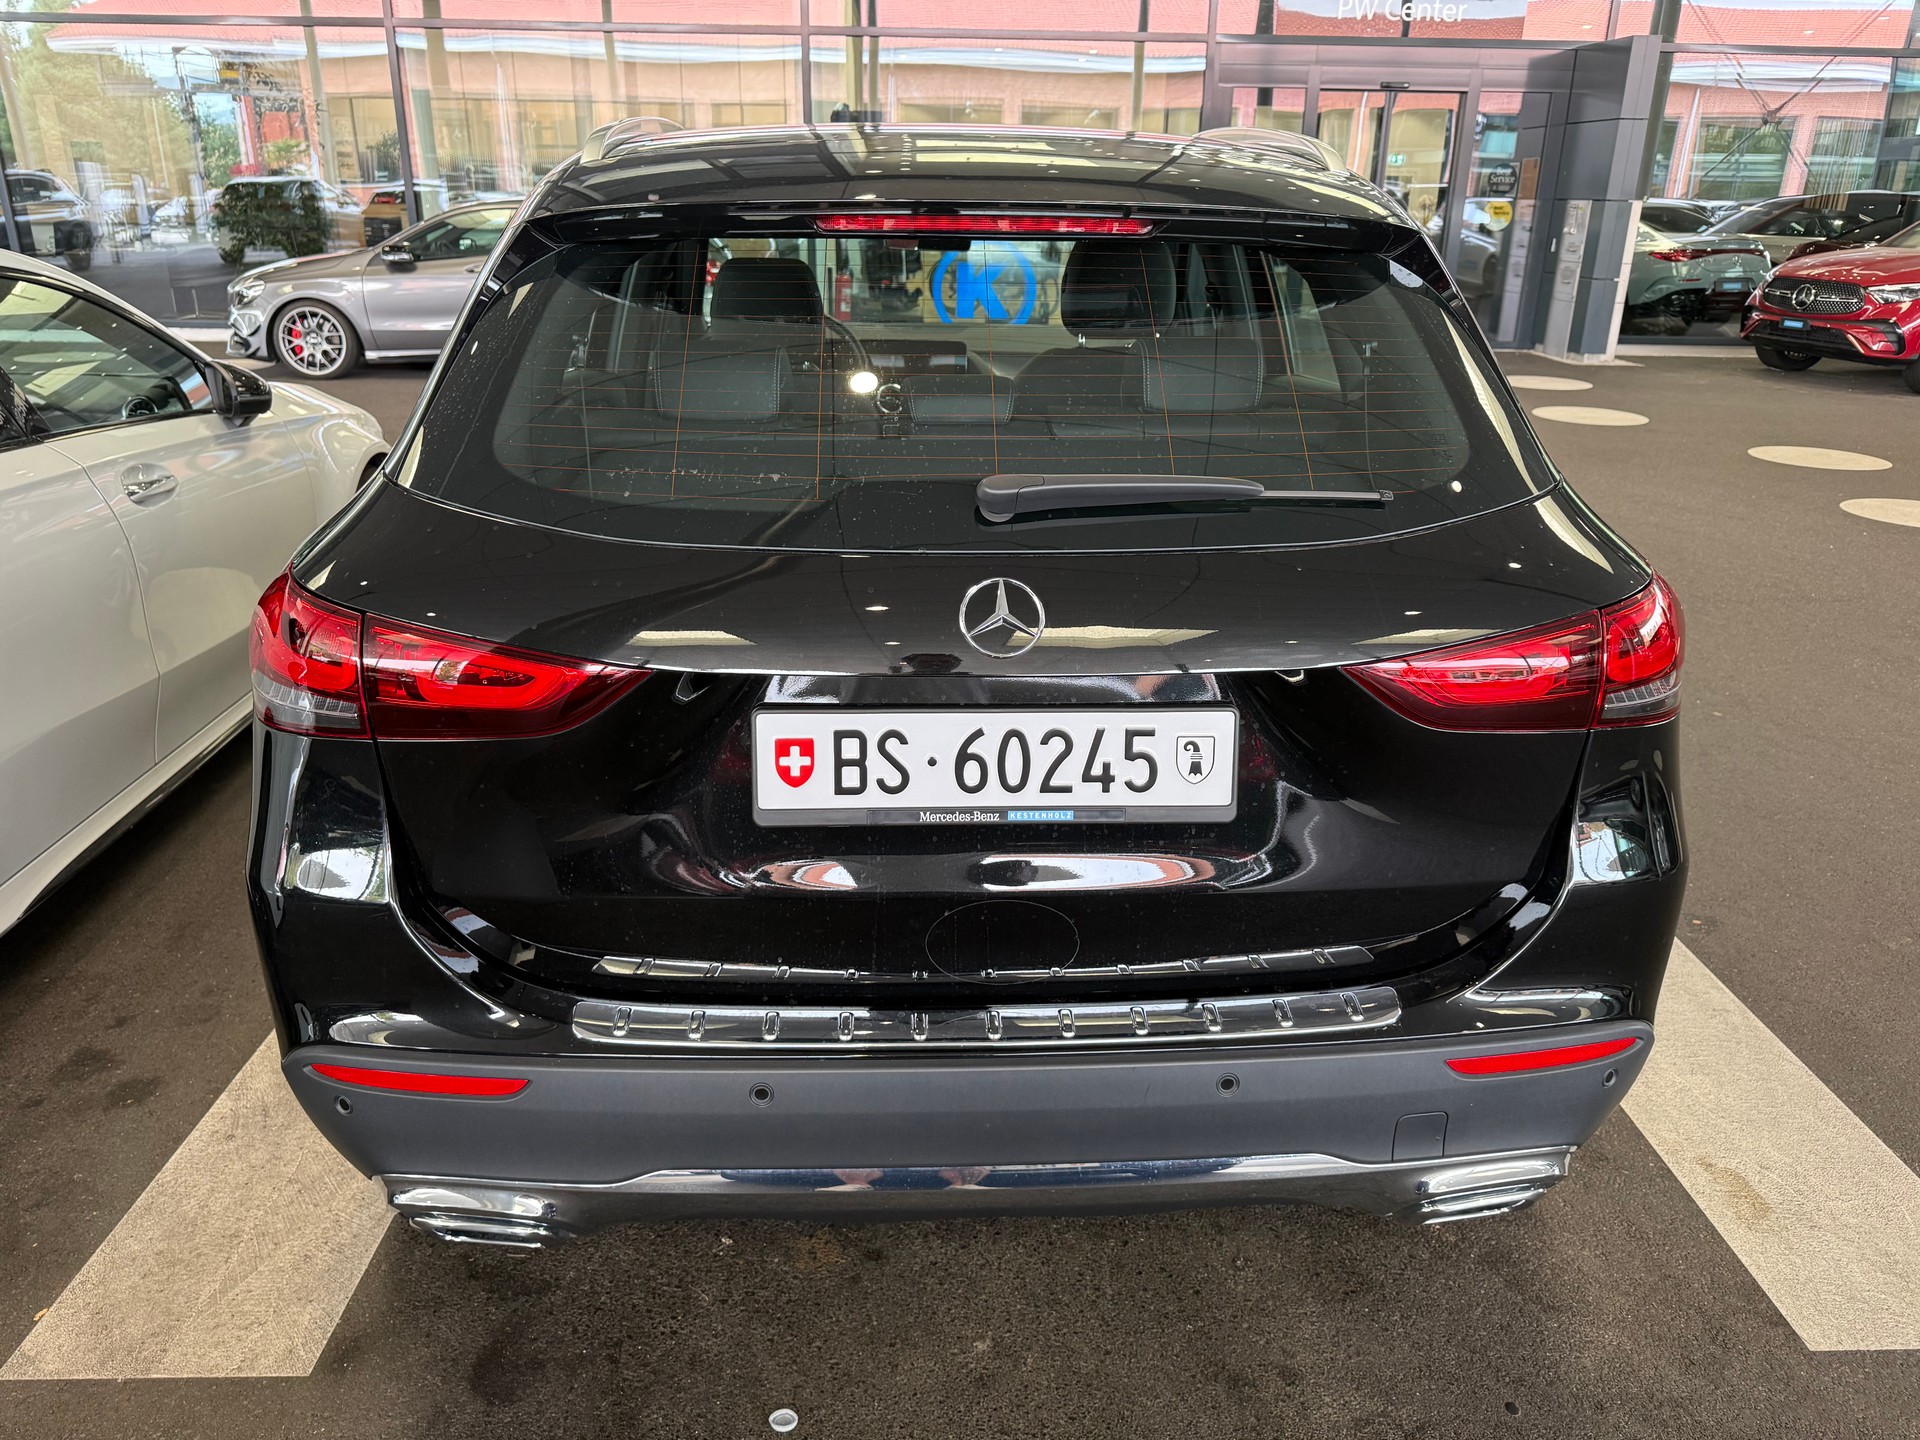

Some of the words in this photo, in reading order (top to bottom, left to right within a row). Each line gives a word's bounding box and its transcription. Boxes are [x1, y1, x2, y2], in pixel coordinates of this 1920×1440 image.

[1337, 0, 1377, 20] PW
[1384, 0, 1468, 22] Center
[1490, 174, 1515, 183] Service
[956, 262, 1009, 319] K
[919, 811, 1000, 822] Mercedes-Benz
